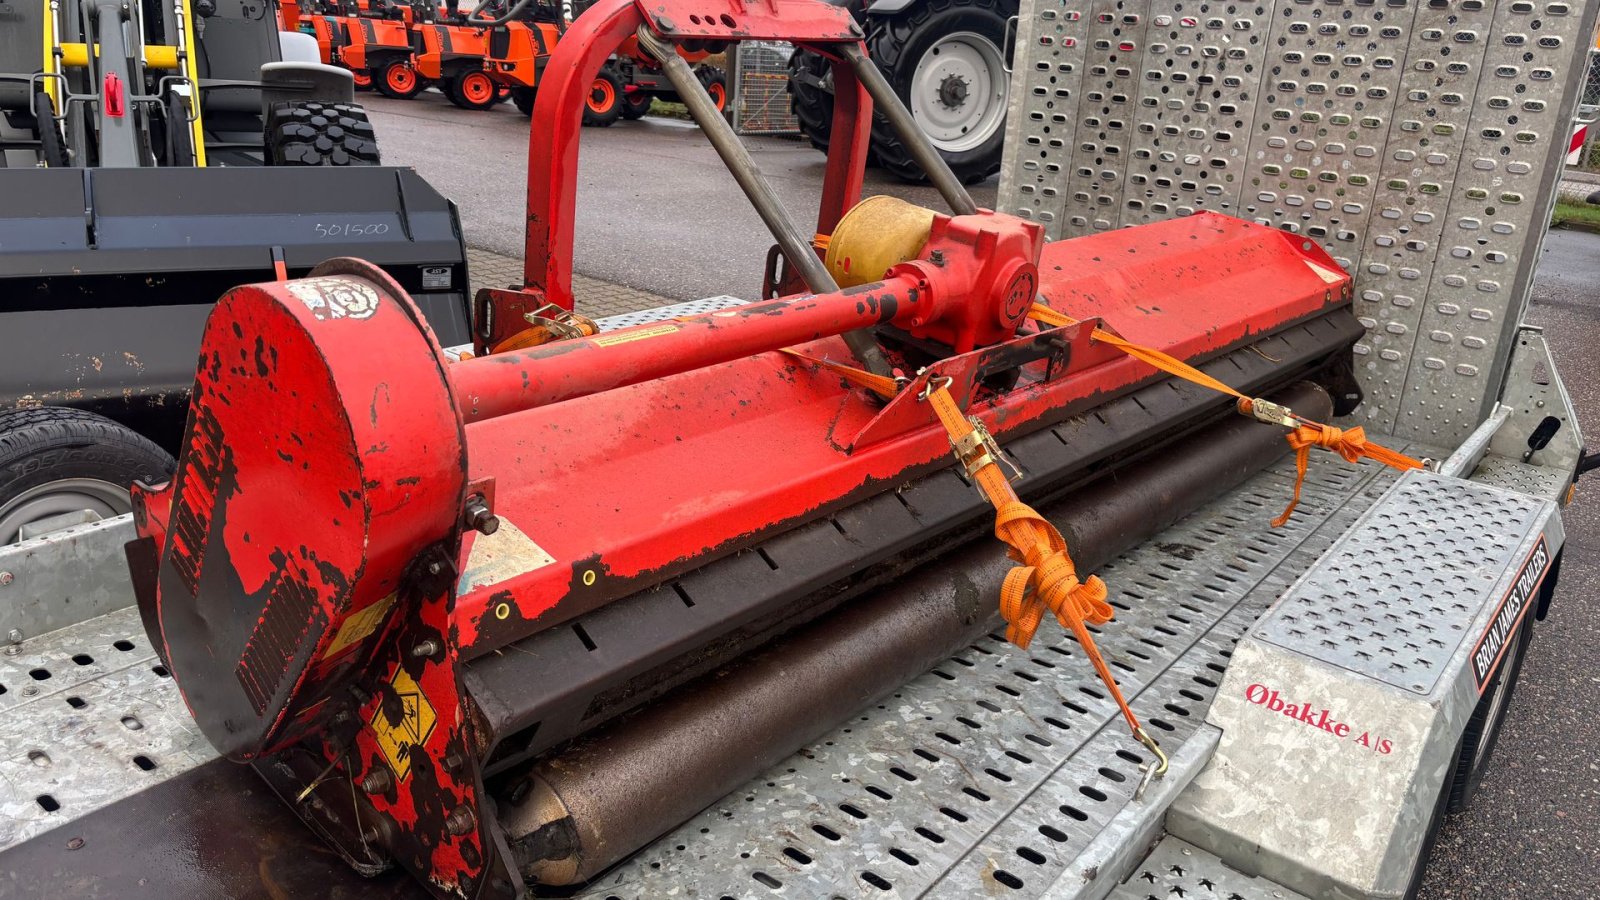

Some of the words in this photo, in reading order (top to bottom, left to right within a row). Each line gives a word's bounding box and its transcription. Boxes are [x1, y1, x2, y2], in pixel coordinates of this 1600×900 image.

[315, 223, 389, 239] 501500
[1475, 631, 1501, 679] BRIAN
[1498, 589, 1521, 643] JAMES
[1517, 544, 1546, 601] TRAILERS
[1245, 683, 1351, 737] Øbakke
